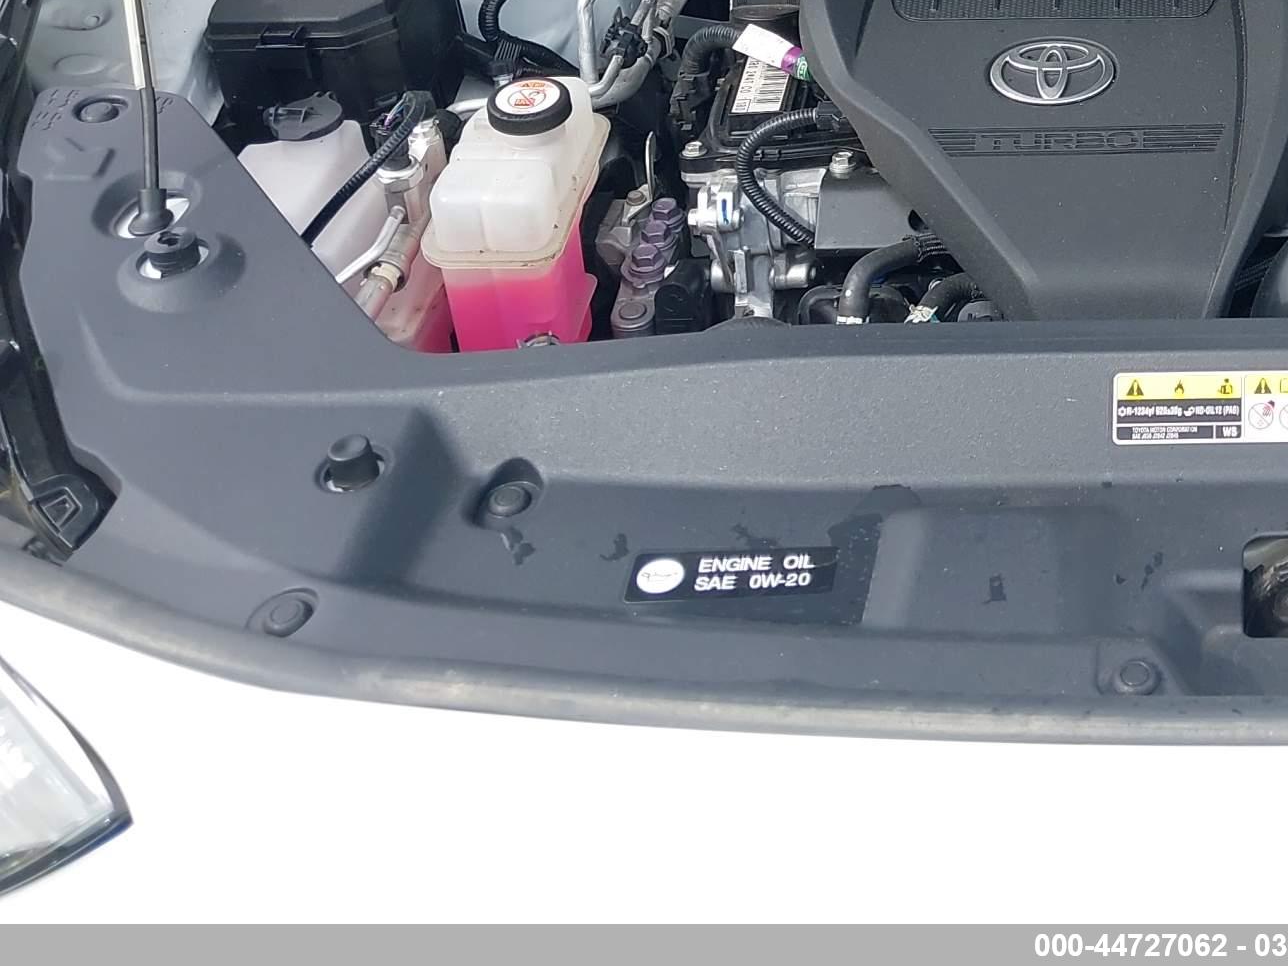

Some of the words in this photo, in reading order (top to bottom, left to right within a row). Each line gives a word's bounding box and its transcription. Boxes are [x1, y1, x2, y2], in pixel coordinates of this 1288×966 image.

[976, 132, 1144, 151] TURBO
[698, 556, 773, 573] ENGINE
[783, 554, 815, 570] OIL
[694, 575, 737, 591] SAE
[749, 572, 811, 589] 0W-20
